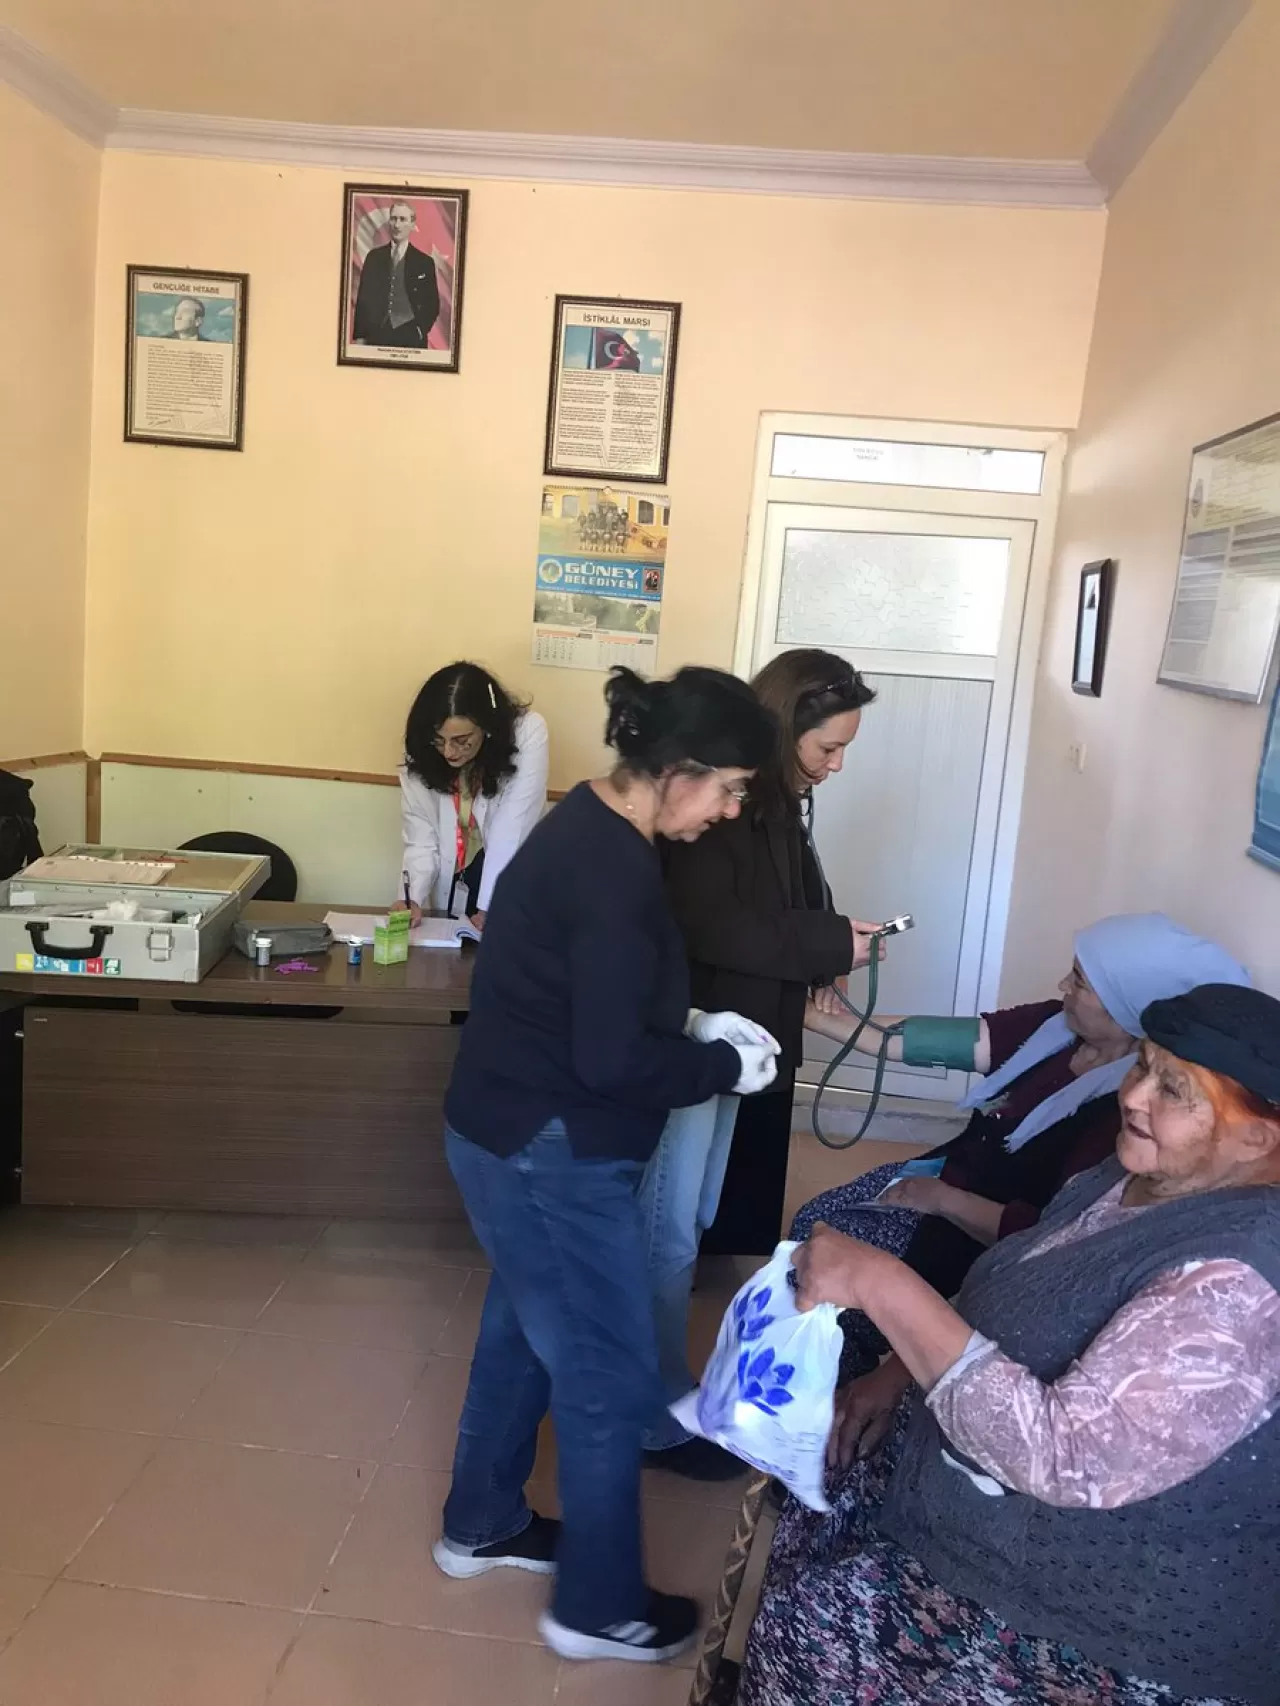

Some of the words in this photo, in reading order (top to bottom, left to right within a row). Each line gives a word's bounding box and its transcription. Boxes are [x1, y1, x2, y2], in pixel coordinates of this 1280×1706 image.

[623, 316, 651, 327] MARŞI
[565, 562, 638, 579] GÜNEY
[564, 576, 638, 589] BELEDİYESİ
